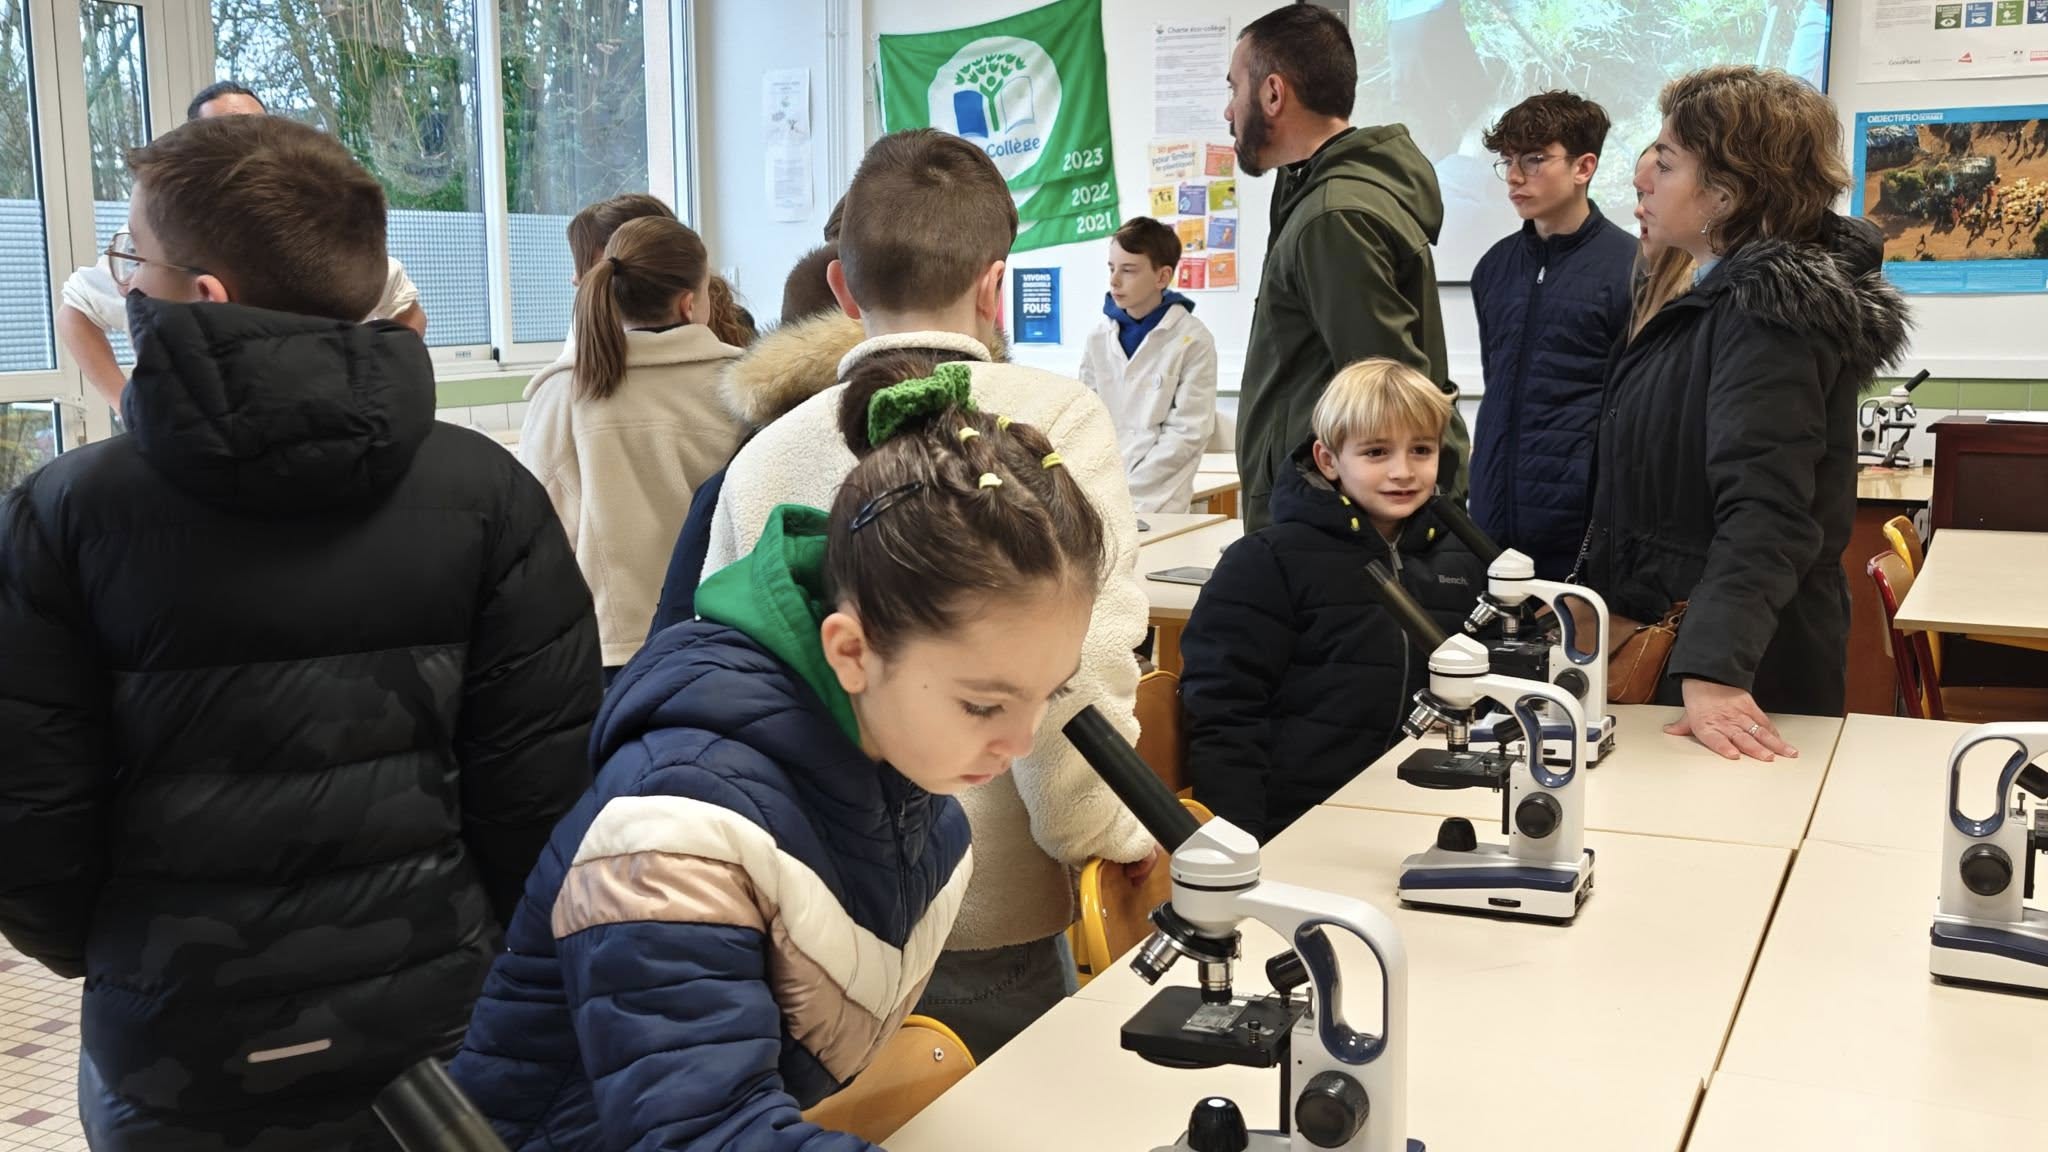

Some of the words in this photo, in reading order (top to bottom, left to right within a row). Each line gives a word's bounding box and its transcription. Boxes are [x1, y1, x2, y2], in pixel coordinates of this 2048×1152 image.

[1867, 113, 1911, 123] OBJECTIFS
[1062, 147, 1104, 172] 2023
[1071, 181, 1111, 207] 2022
[1076, 211, 1113, 234] 2021
[1022, 273, 1051, 281] VIVONS
[1023, 303, 1051, 314] FOUS
